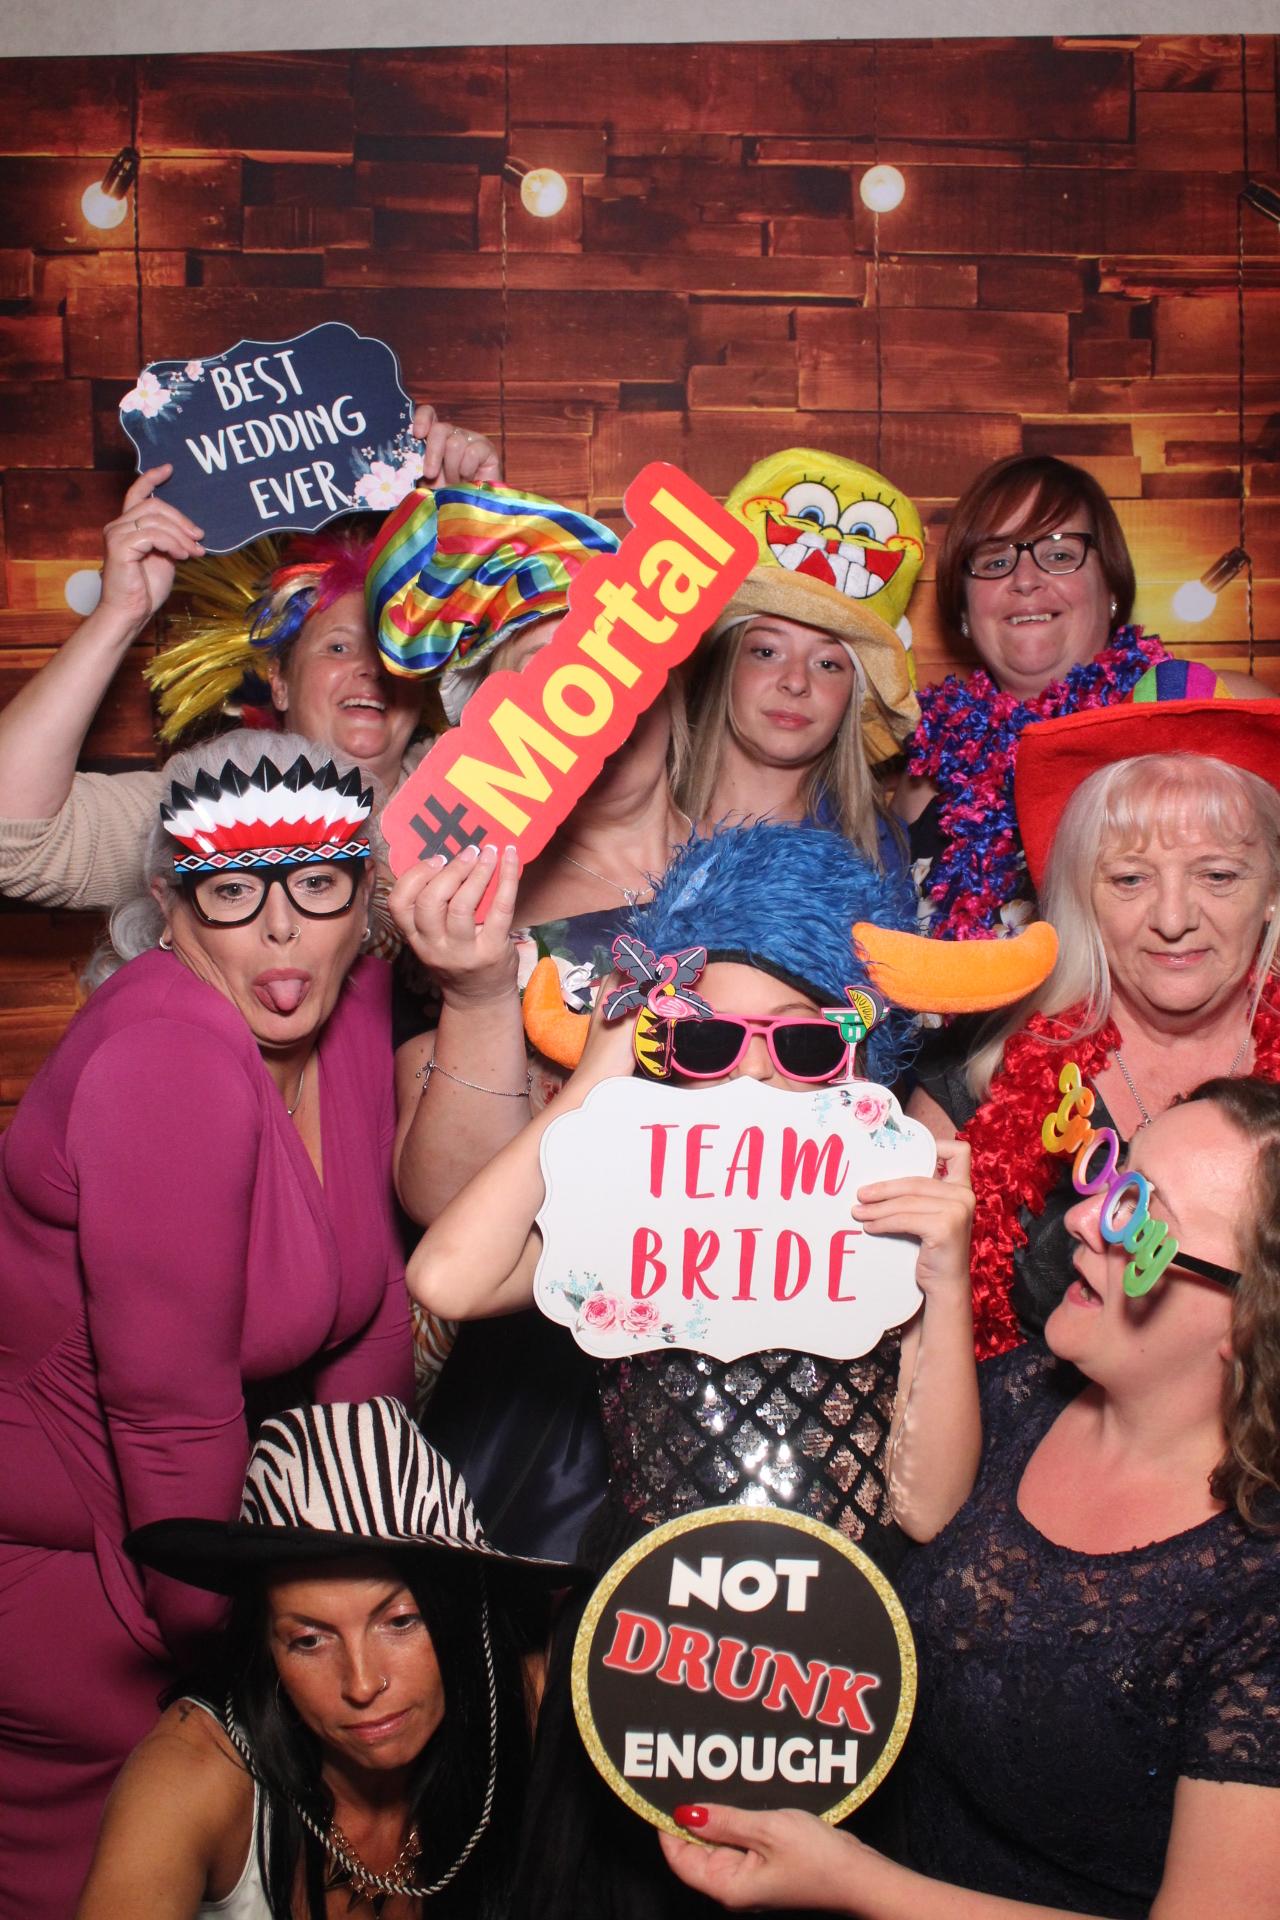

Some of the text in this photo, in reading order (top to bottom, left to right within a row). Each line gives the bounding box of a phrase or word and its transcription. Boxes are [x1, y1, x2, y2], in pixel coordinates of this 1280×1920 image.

[211, 350, 303, 411] BEST
[185, 395, 367, 474] WEDDING
[249, 461, 351, 520] EVER
[409, 487, 736, 865] #Mortal
[640, 1124, 850, 1200] TEAM
[630, 1227, 863, 1302] BRIDE
[668, 1556, 820, 1612] NOT
[601, 1609, 881, 1735] DRUNK
[623, 1731, 859, 1784] ENOUGH
